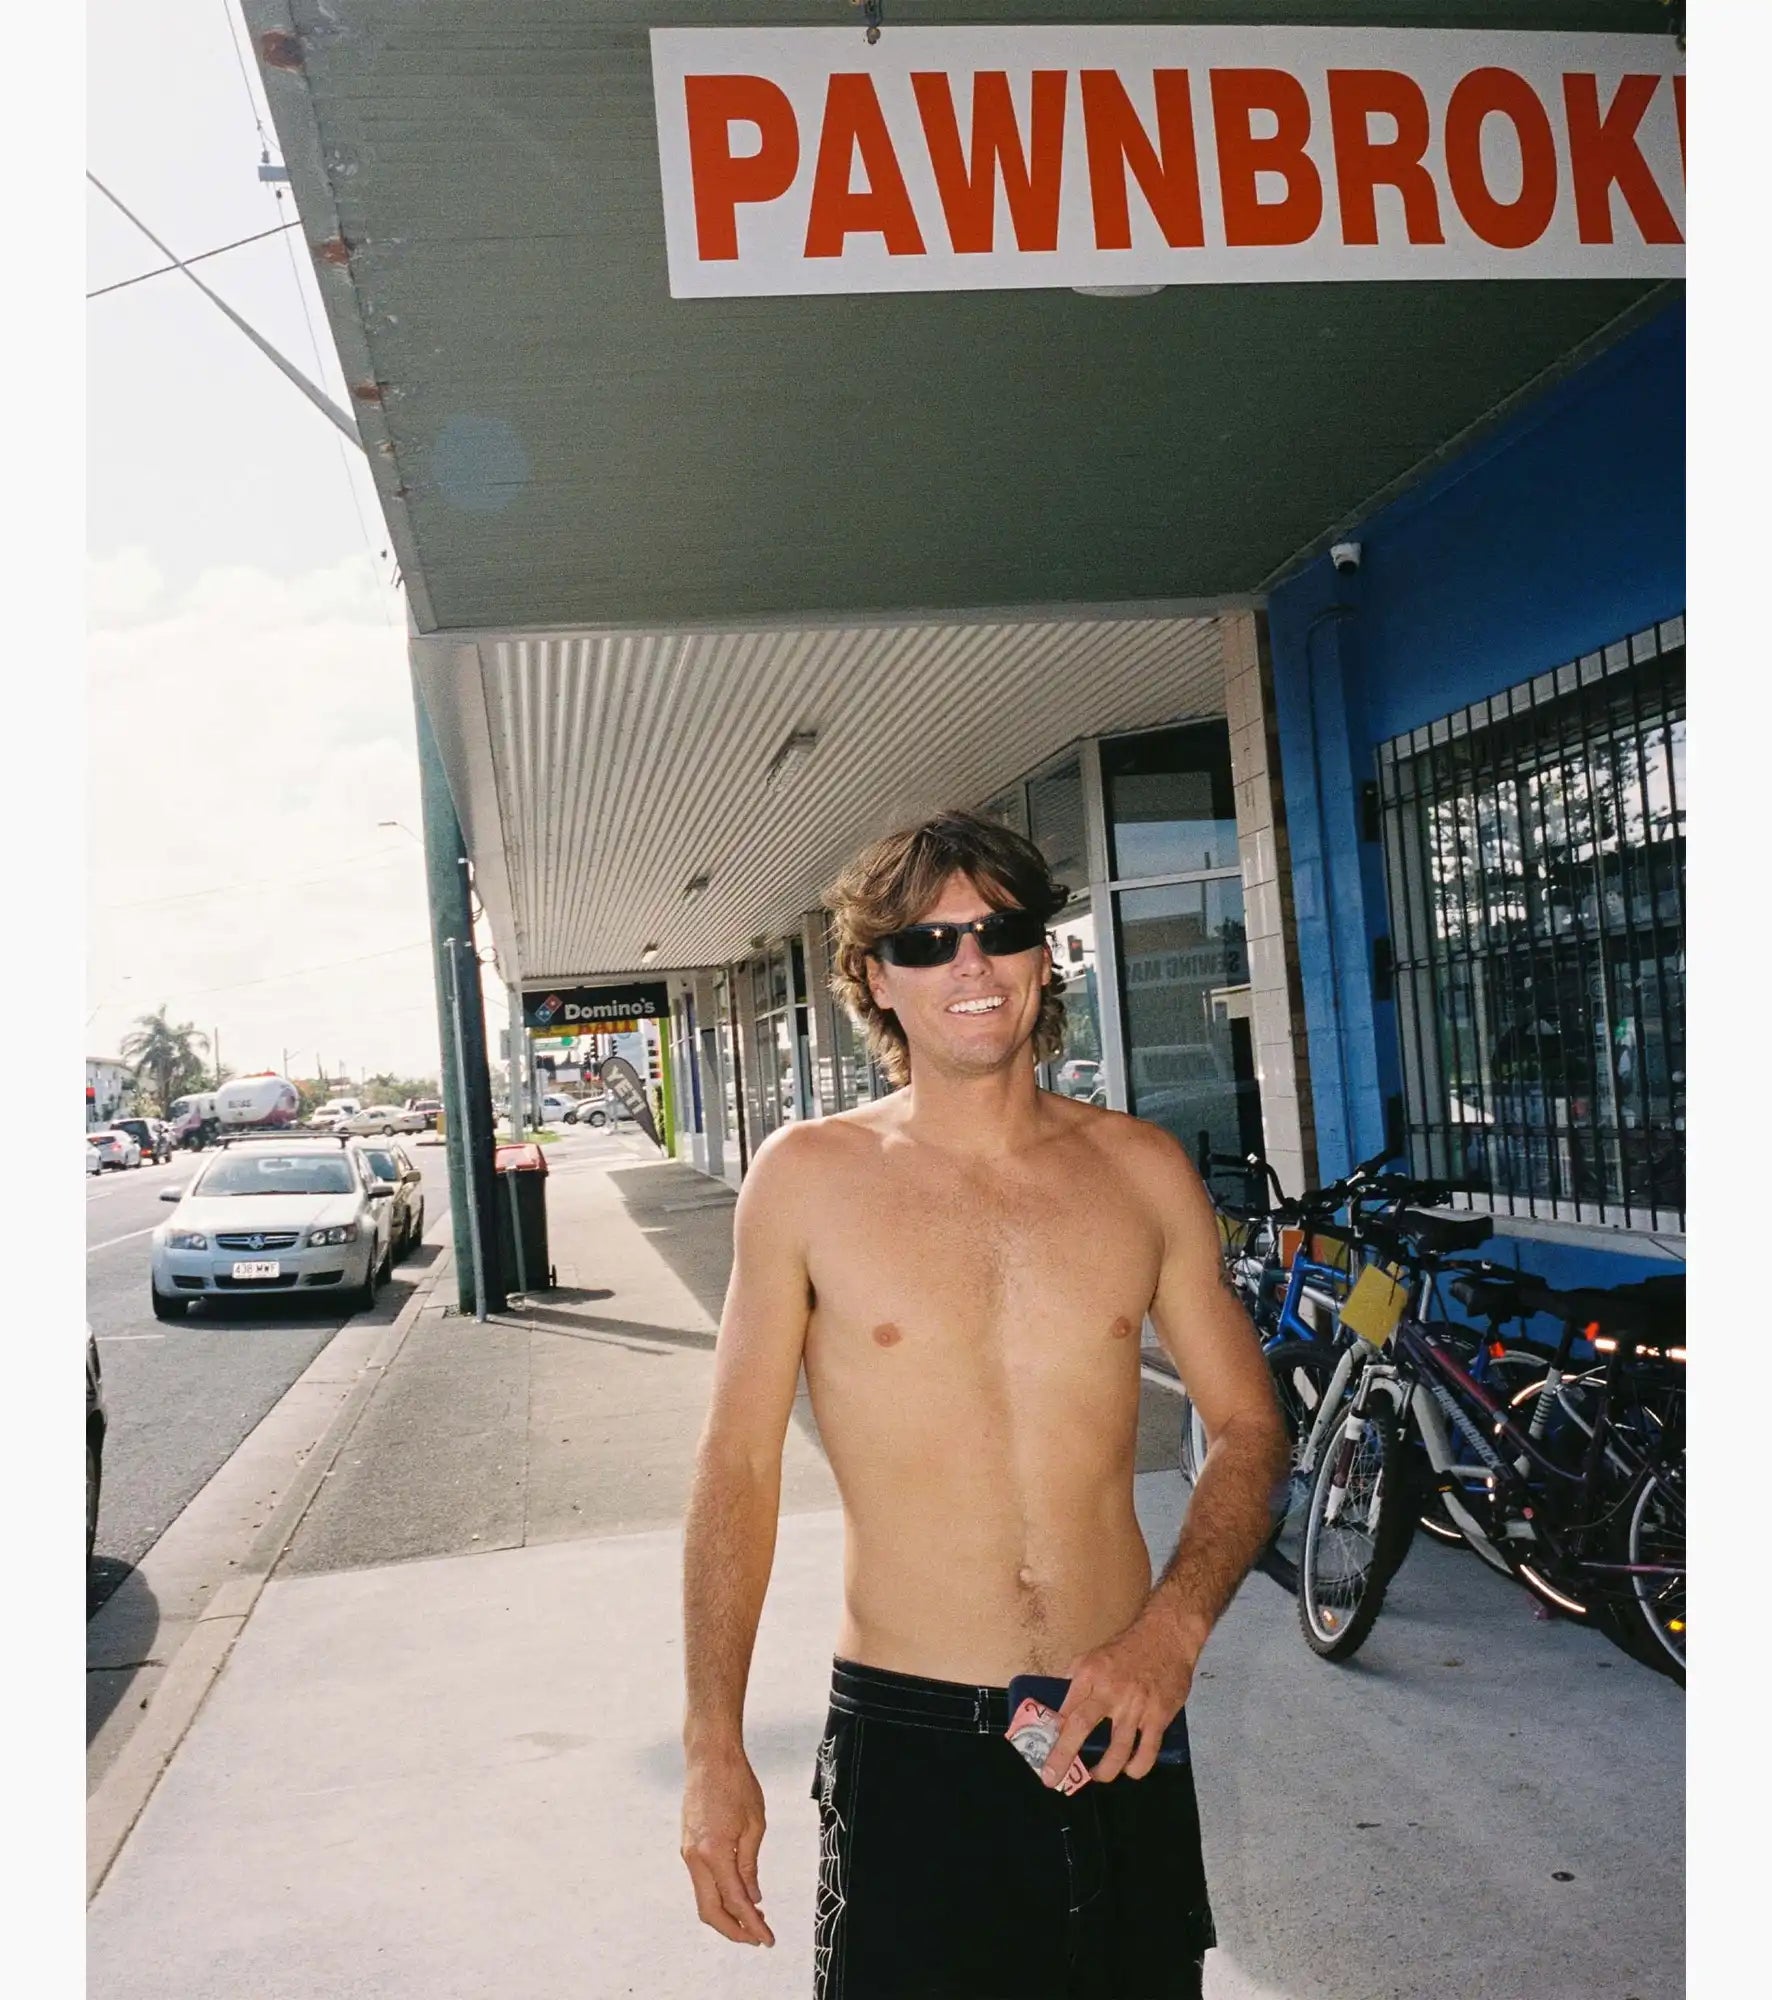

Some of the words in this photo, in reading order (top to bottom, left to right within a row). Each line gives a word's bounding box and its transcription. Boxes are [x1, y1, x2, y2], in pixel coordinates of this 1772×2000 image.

[684, 67, 1686, 261] PAWNBROK
[564, 997, 656, 1021] Domino's
[606, 1064, 646, 1115] YETI
